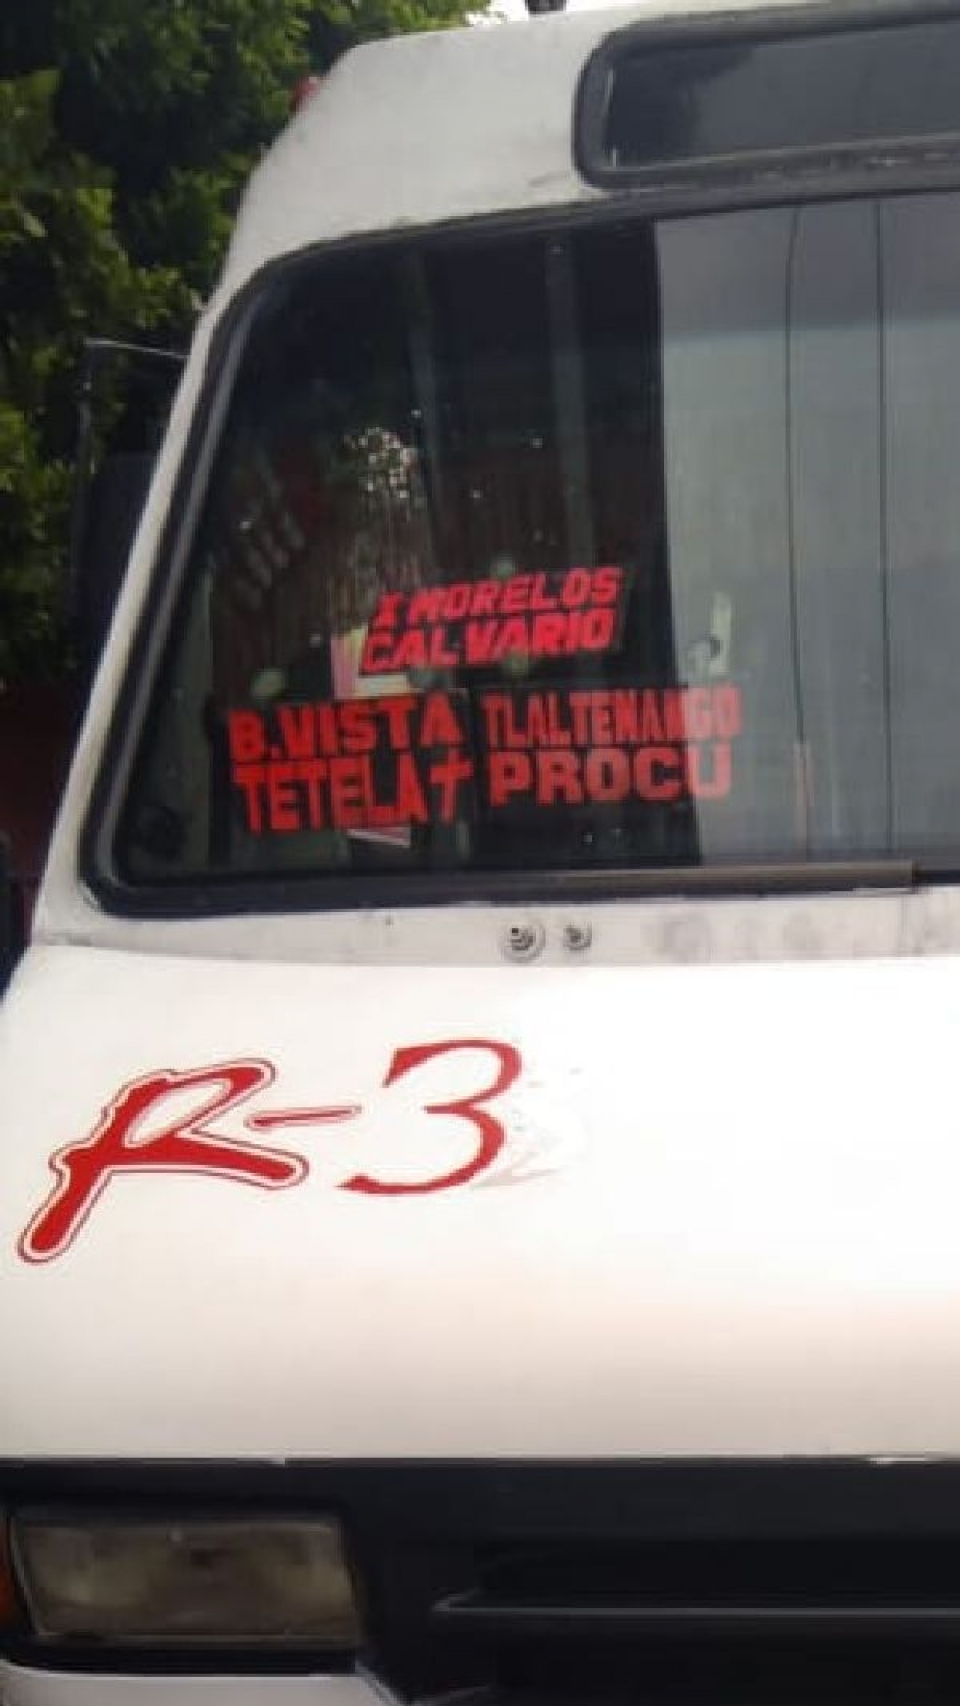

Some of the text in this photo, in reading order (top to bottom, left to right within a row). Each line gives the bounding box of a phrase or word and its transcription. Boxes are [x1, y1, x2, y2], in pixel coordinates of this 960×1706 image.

[409, 567, 622, 624] MORELOS
[360, 609, 616, 672] CALVARIO
[228, 685, 742, 761] B.VISTA TLALTENANGO
[488, 746, 732, 806] PROCU
